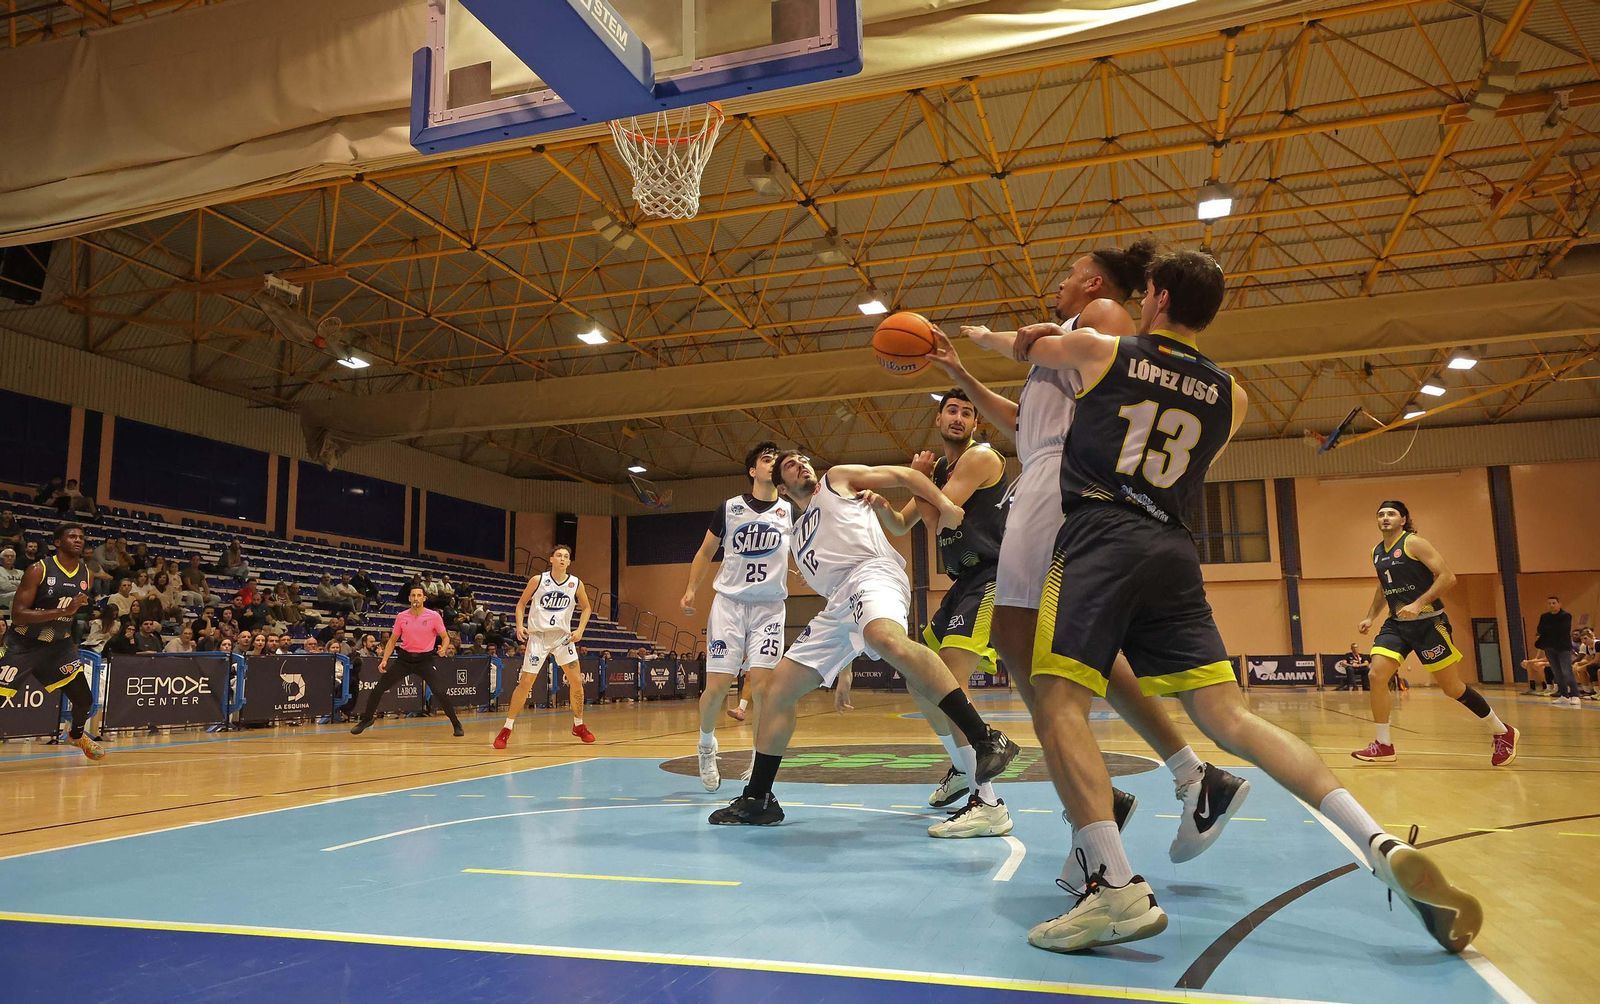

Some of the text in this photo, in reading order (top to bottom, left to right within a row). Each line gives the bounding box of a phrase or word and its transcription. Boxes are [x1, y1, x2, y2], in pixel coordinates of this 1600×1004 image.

[1127, 358, 1219, 405] LÓPEZ USÓ
[1115, 399, 1202, 489] 13
[747, 524, 759, 533] LA
[734, 531, 781, 554] SALUD
[803, 549, 819, 576] 12
[745, 563, 767, 582] 25
[1384, 569, 1392, 583] 1
[540, 595, 570, 608] SALUD
[549, 614, 556, 626] 6
[567, 646, 574, 655] 6
[760, 638, 780, 657] 25
[0, 665, 19, 683] 10
[397, 687, 418, 696] LABOR
[446, 686, 477, 696] ASESORES
[136, 697, 200, 707] CENTER
[283, 702, 310, 710] ESQUINA
